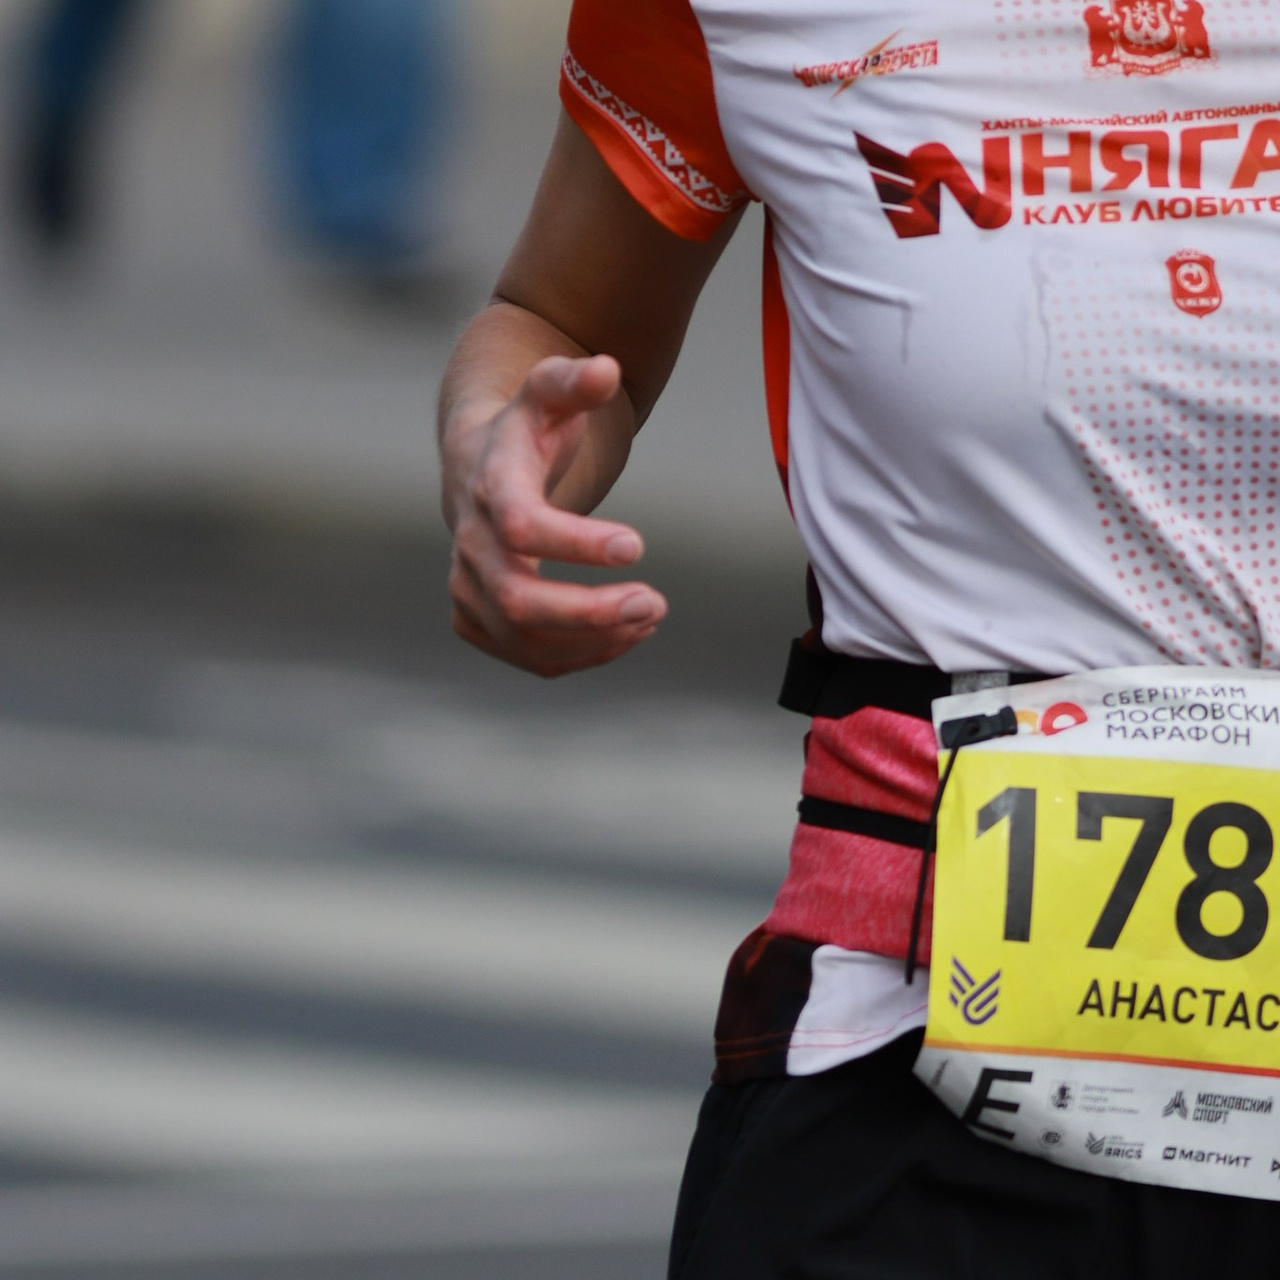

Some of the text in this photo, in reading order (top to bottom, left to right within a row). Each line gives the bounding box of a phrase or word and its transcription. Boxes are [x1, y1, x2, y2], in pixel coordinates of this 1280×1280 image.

[1022, 198, 1121, 226] КЛУБ
[1105, 724, 1252, 747] МАРАФОН
[1195, 1092, 1274, 1114] МОСКОВСКИЙ
[1192, 1107, 1231, 1125] СПОРТ
